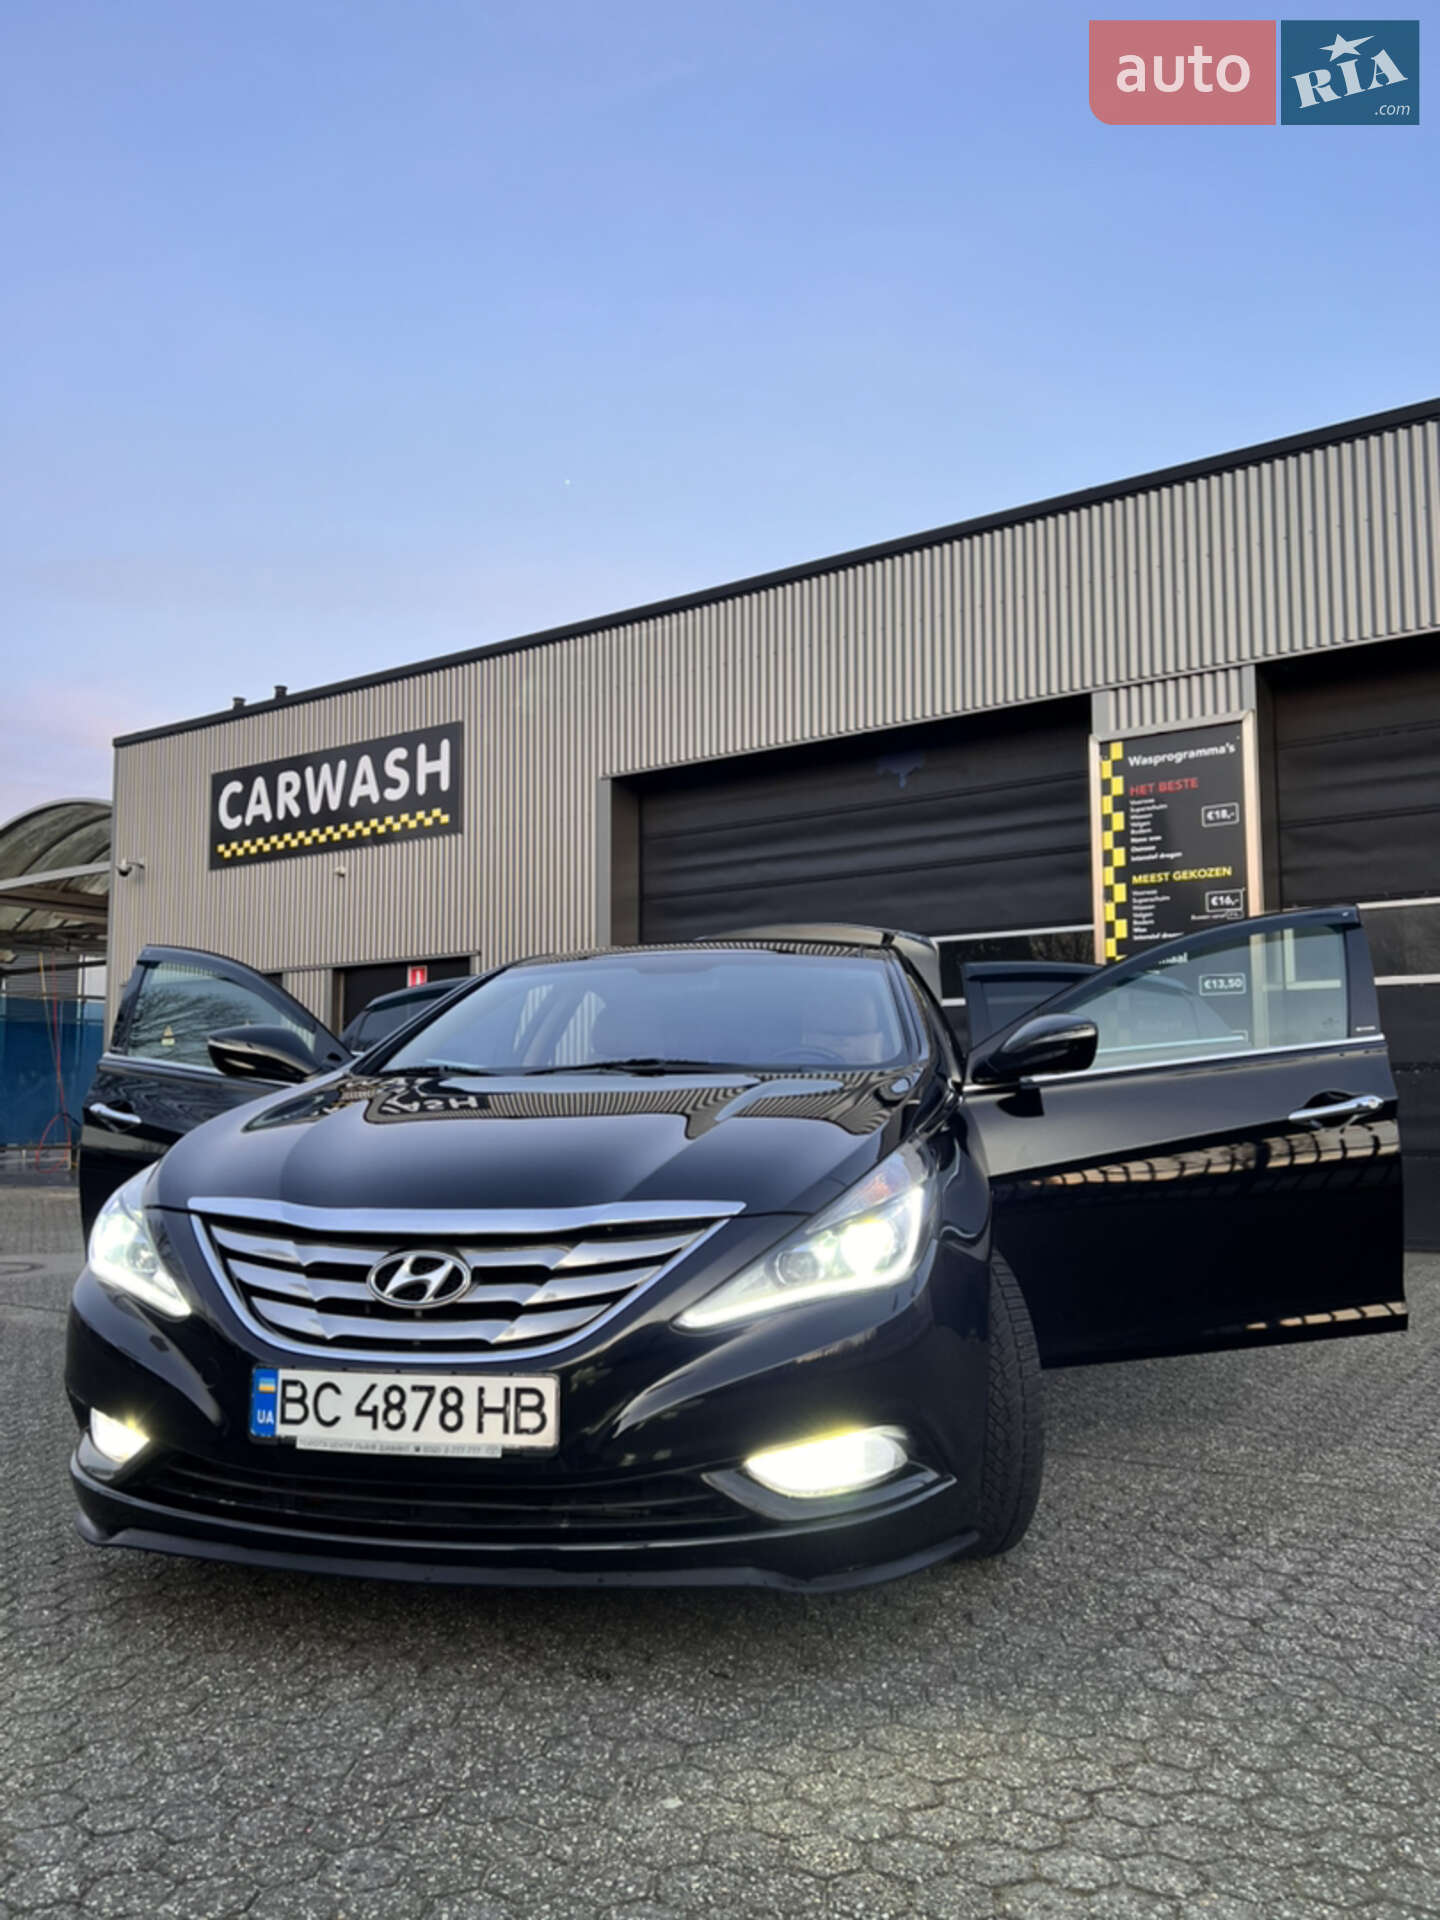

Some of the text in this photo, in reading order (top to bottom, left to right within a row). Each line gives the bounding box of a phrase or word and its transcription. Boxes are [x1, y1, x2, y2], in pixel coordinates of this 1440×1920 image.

[1128, 742, 1236, 767] Wasprogramma's
[218, 738, 450, 830] CARWASH
[1129, 777, 1198, 797] HET BESTE
[1131, 866, 1232, 885] MEEST GEKOZEN
[1204, 978, 1244, 990] €13,50
[256, 1409, 274, 1425] UA
[280, 1378, 548, 1436] BC 4878 HB
